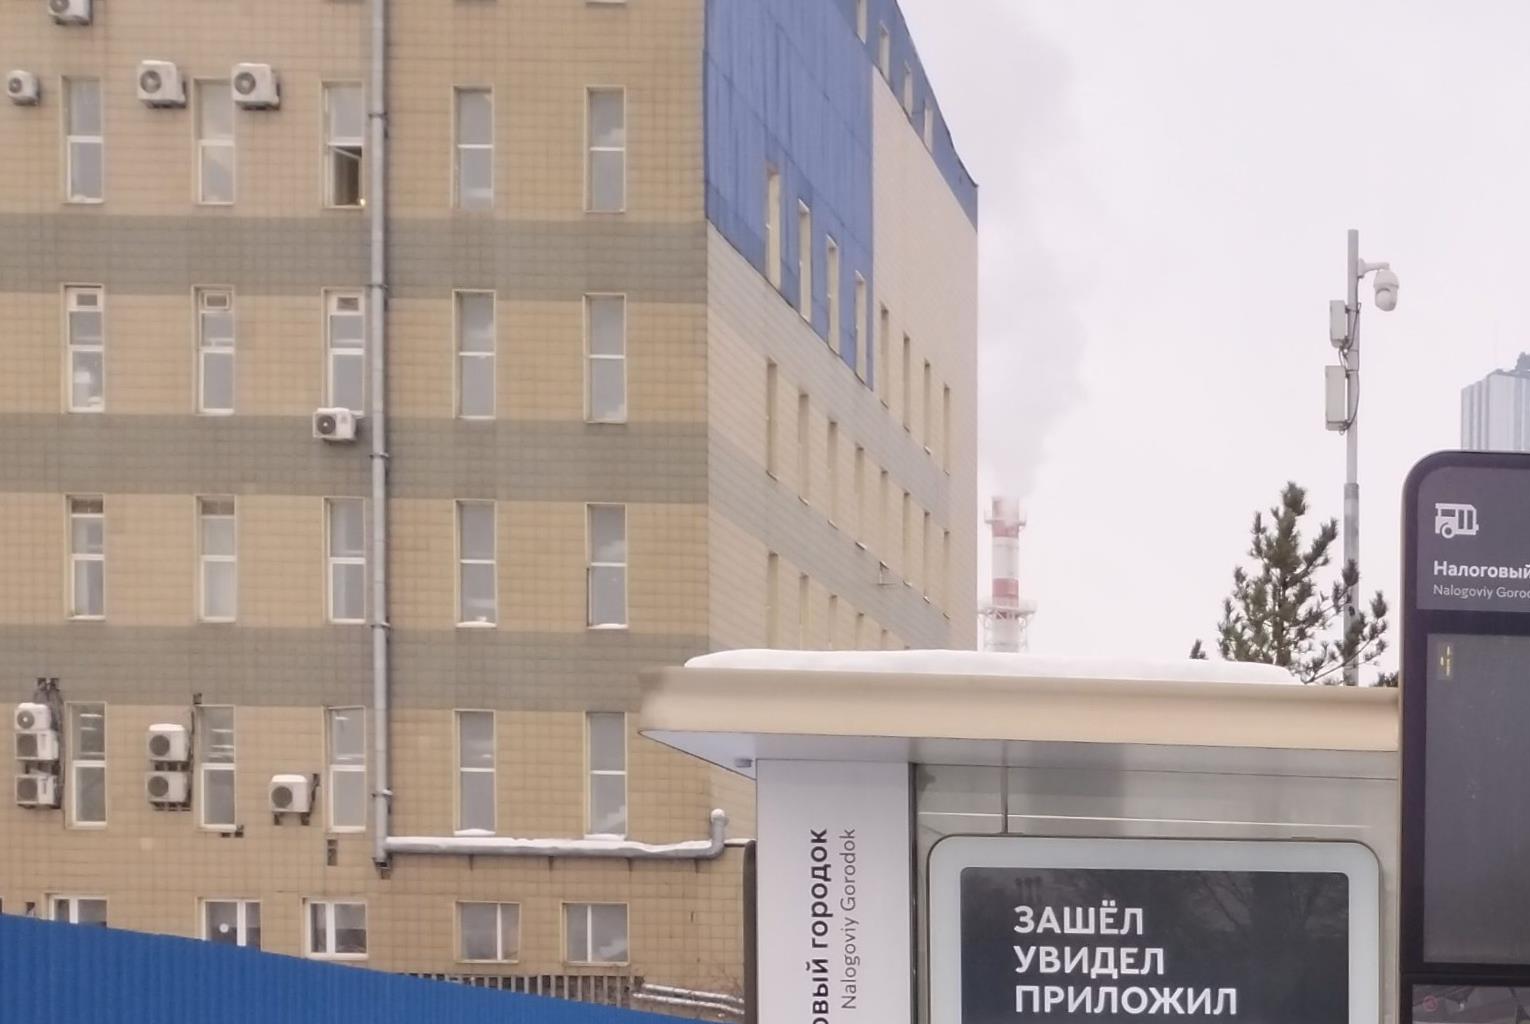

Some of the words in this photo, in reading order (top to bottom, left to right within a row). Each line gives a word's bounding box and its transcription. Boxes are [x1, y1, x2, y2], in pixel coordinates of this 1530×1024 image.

[1433, 584, 1493, 600] Nalogoviy
[839, 828, 857, 912] Gorodok
[810, 828, 834, 949] городок
[1013, 900, 1144, 935] ЗАШЁЛ
[840, 917, 861, 1010] Nalogoviy
[1013, 945, 1165, 979] УВИДЕЛ
[1015, 984, 1238, 1015] ПРИЛОЖИЛ
